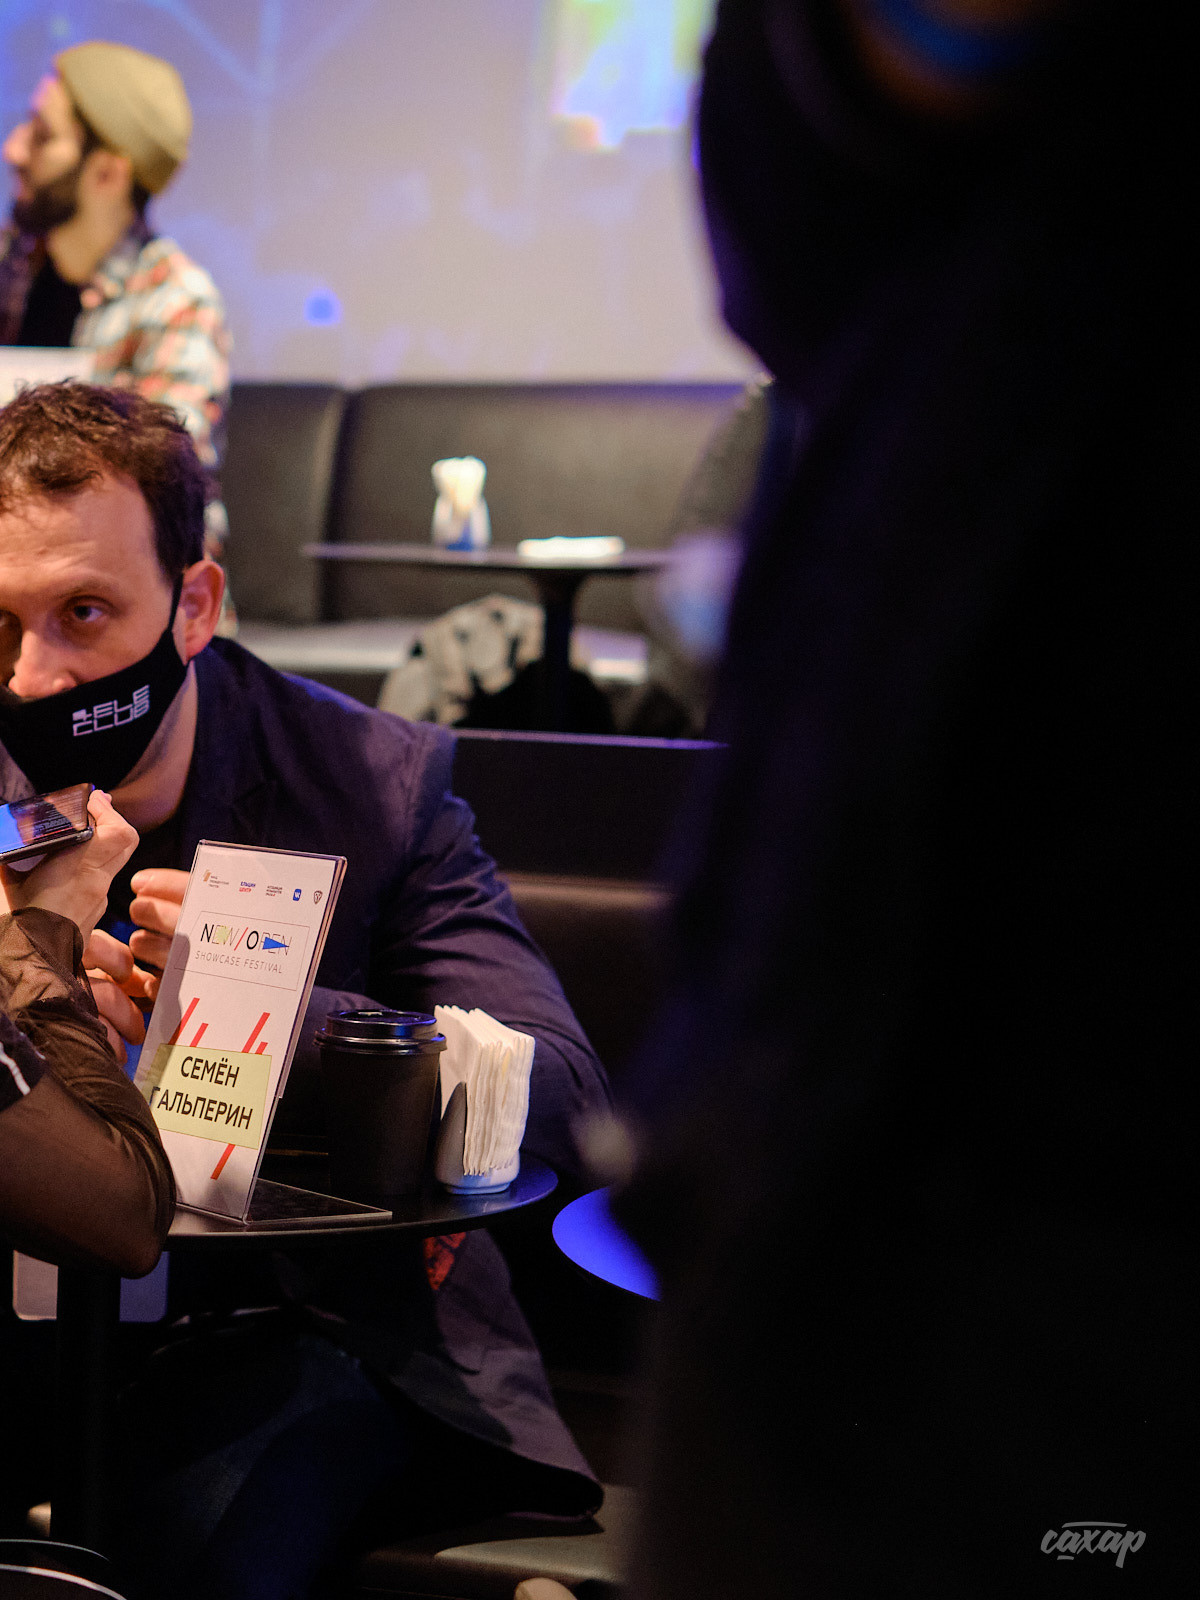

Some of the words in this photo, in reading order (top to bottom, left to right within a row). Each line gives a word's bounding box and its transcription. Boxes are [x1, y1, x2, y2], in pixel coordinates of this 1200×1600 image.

[72, 700, 150, 736] CLUB
[195, 950, 241, 967] SHOWCASE
[243, 958, 282, 974] FESTIVAL
[180, 1056, 240, 1088] СЕМЁН
[148, 1086, 253, 1130] ГАЛЬПЕРИН
